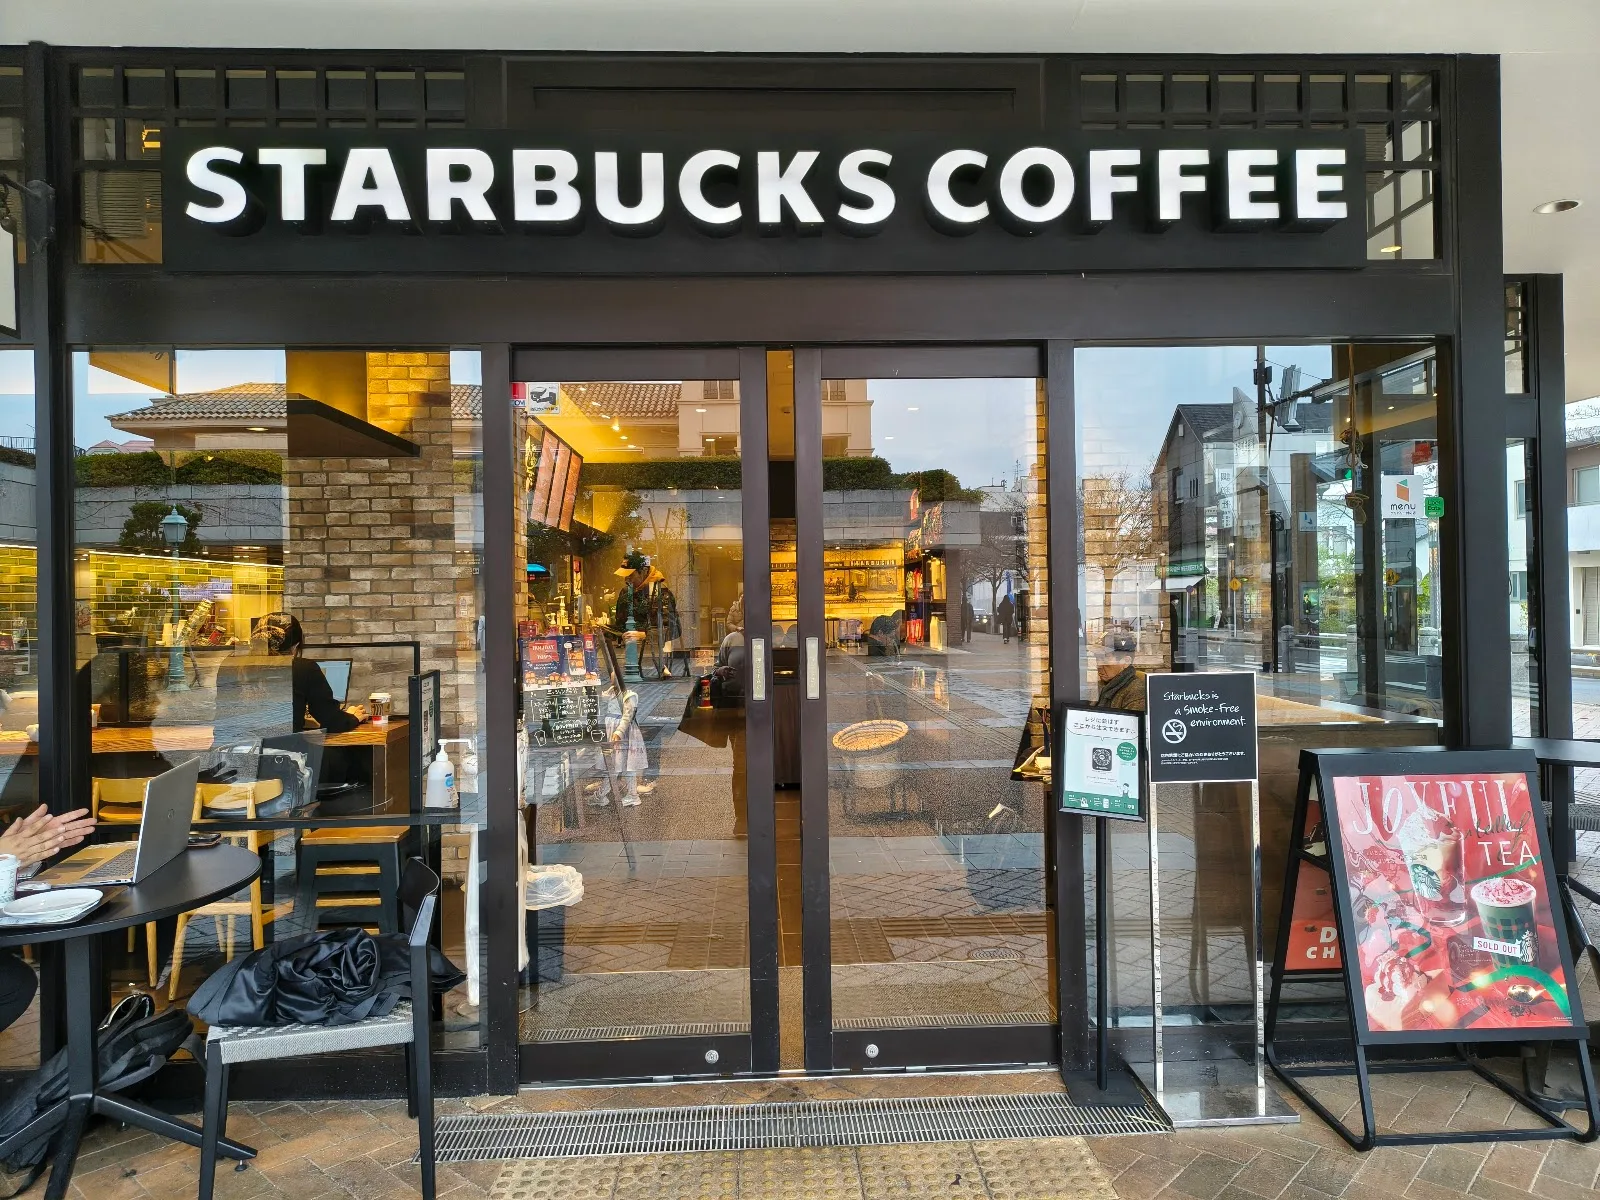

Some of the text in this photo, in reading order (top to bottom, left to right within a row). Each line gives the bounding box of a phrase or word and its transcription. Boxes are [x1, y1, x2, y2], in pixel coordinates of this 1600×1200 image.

[184, 146, 1349, 225] STARBUCKS COFFEE
[1163, 689, 1219, 700] Starbucks is
[1190, 716, 1246, 727] environment.
[1352, 779, 1524, 835] JOYFUL
[1477, 840, 1538, 867] TEA
[1477, 940, 1499, 951] SOLD
[1502, 944, 1518, 954] OUT
